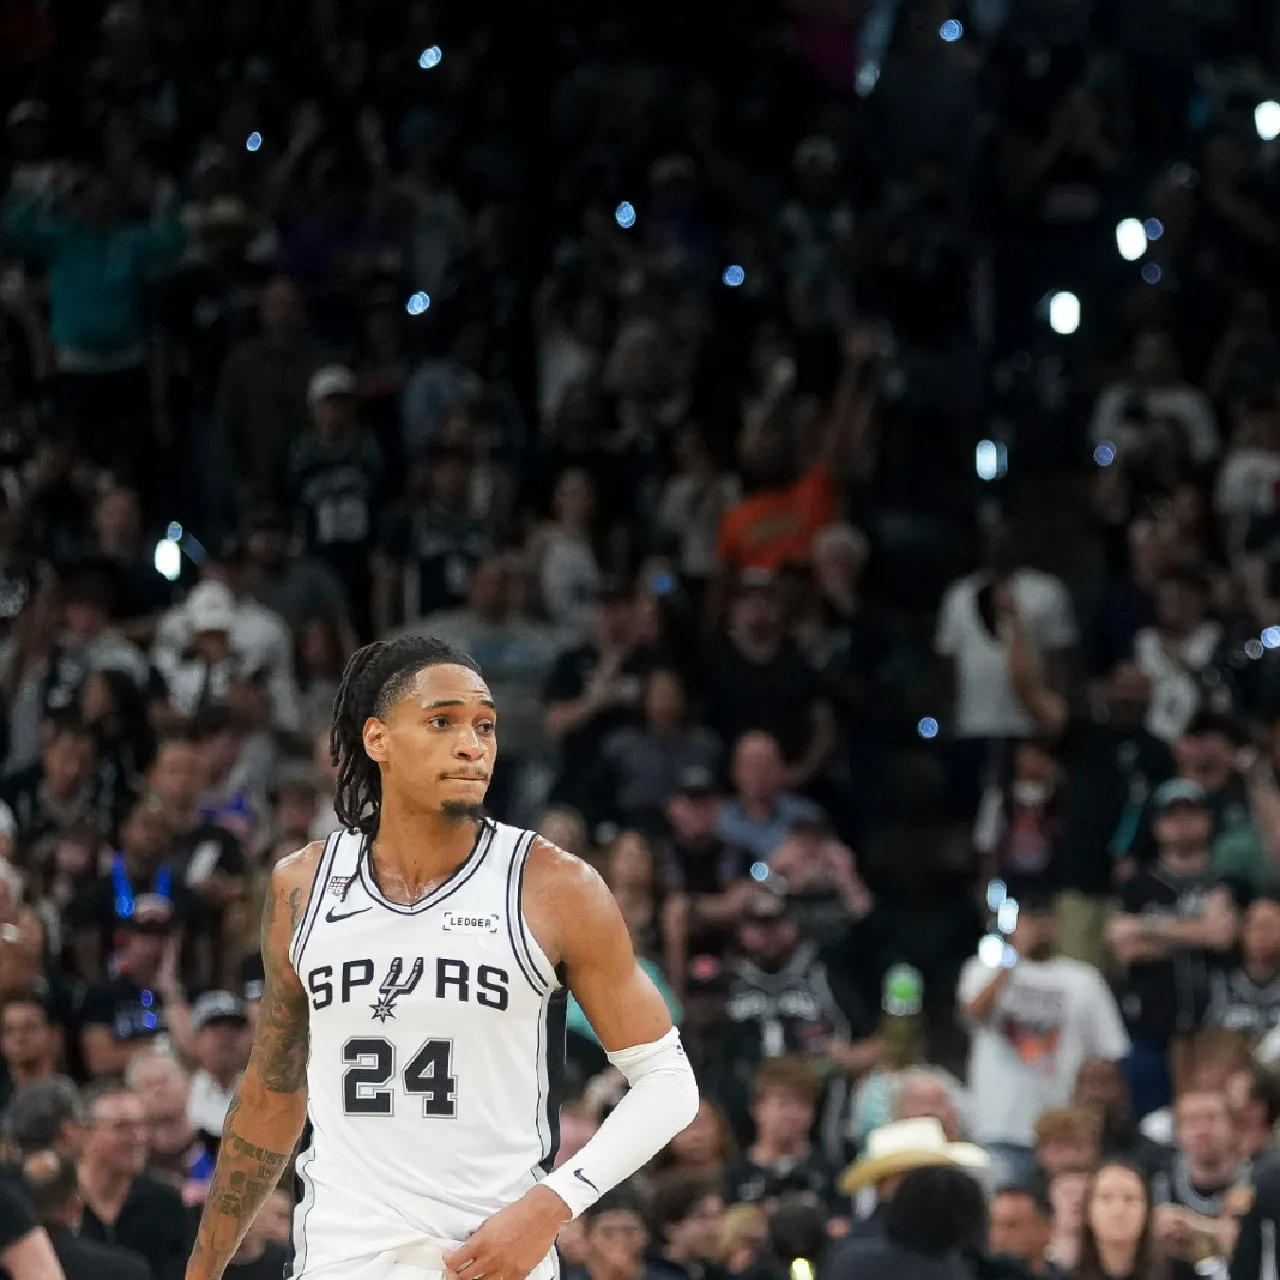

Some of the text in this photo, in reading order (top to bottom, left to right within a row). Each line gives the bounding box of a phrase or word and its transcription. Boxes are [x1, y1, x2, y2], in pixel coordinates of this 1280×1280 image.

[450, 916, 491, 928] LEDGER
[308, 957, 509, 1023] SPURS
[341, 1035, 458, 1119] 24
